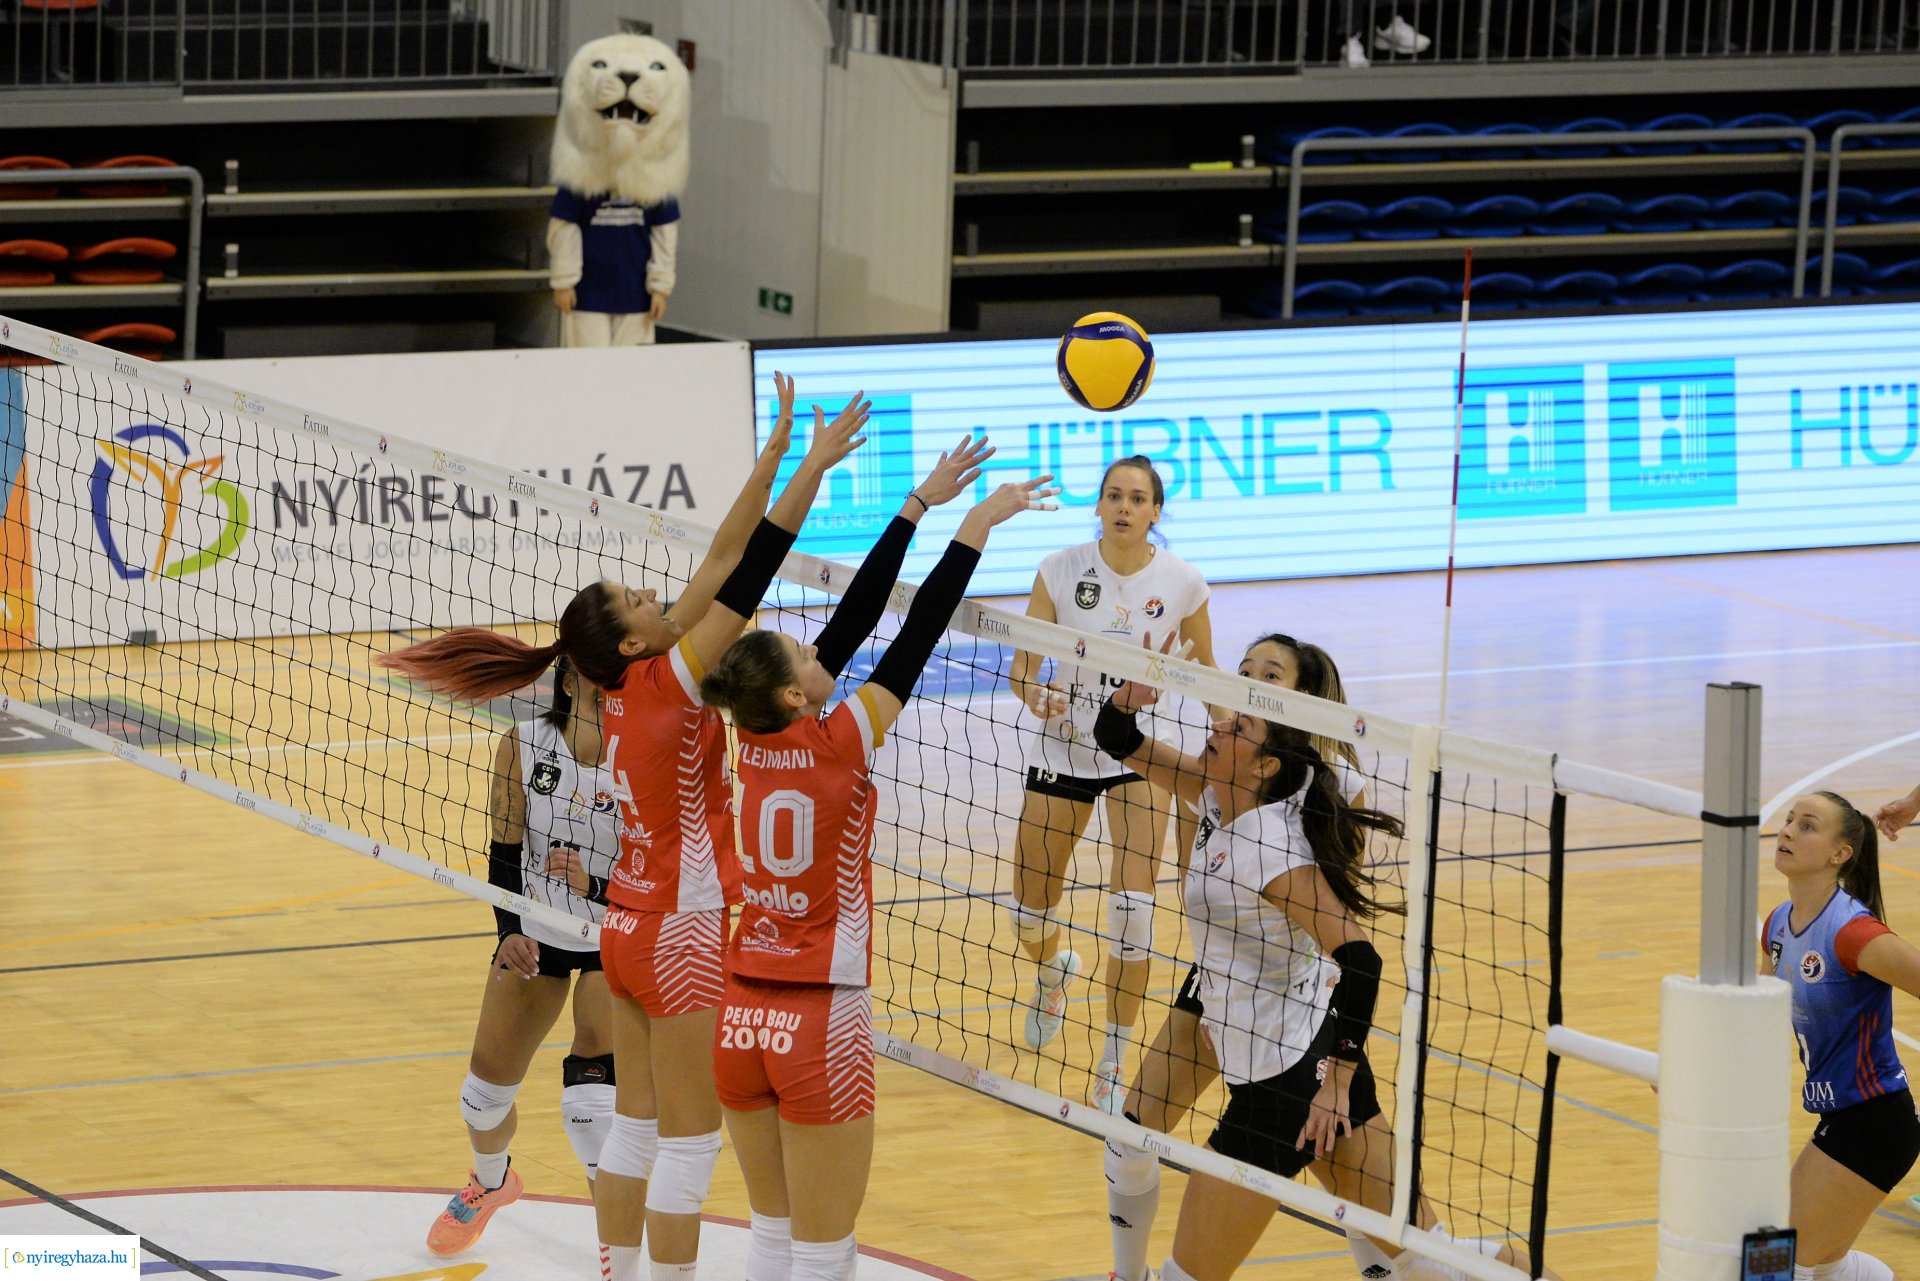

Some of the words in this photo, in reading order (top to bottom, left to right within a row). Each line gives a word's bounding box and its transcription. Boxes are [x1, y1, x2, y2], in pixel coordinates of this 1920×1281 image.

[972, 408, 1397, 508] HÜBNER
[271, 453, 696, 529] NYÍREGÁZA
[977, 611, 1011, 637] FATUM
[606, 694, 624, 717] KISS
[1248, 687, 1285, 715] FATUM
[723, 1005, 764, 1027] PEKA
[766, 1008, 802, 1032] BAU
[721, 1025, 793, 1055] 2000
[571, 1116, 593, 1124] MIKASA
